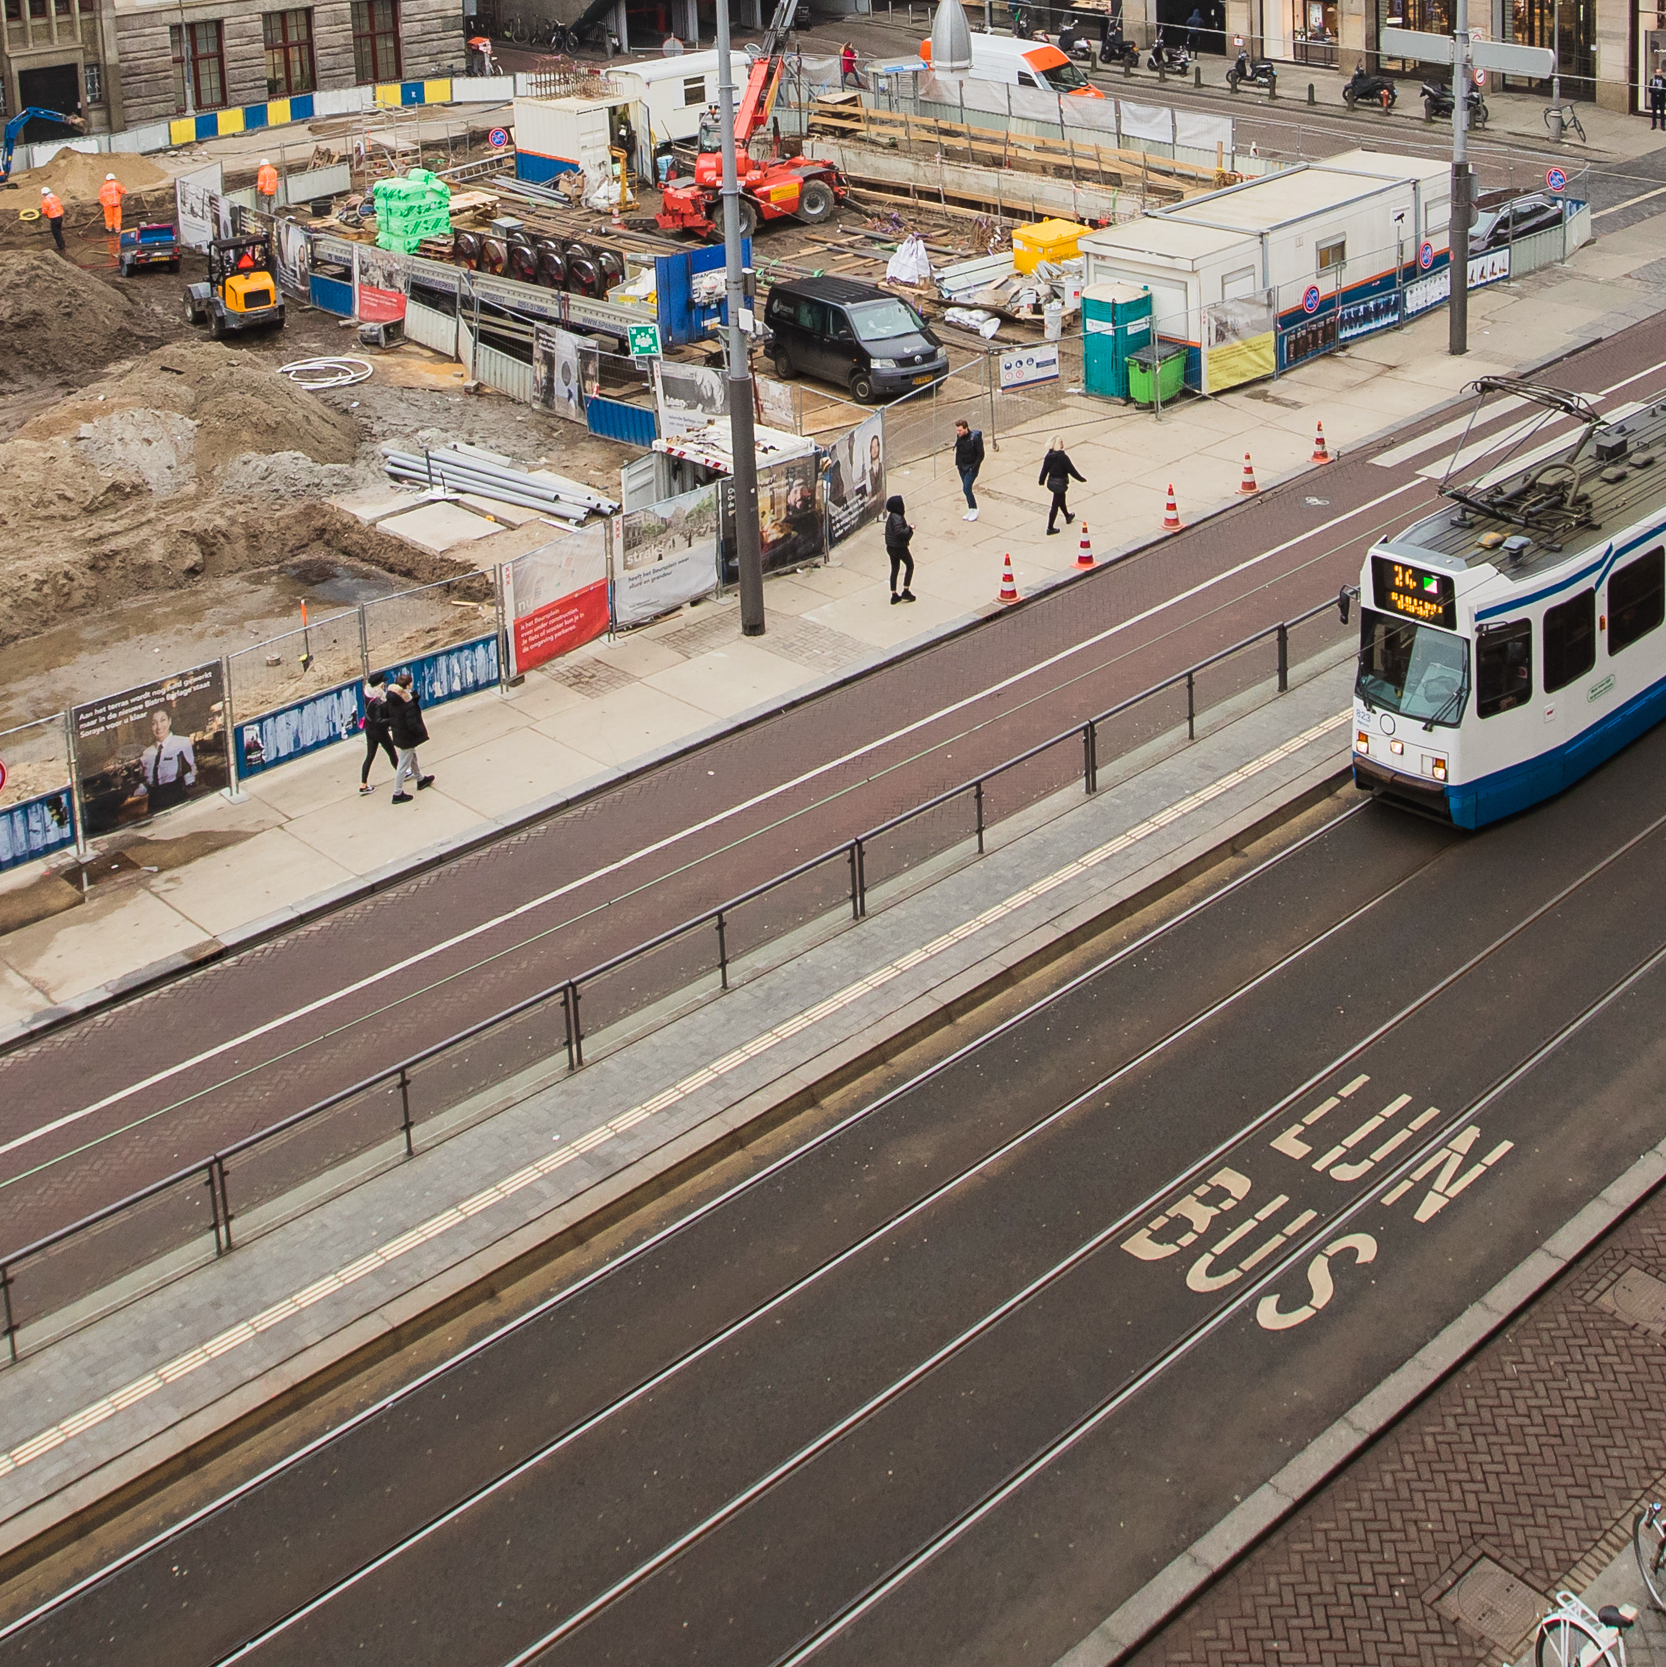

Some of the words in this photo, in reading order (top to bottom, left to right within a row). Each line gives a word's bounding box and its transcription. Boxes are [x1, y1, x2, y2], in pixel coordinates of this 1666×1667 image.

[518, 598, 533, 612] nu
[525, 620, 534, 629] het
[79, 711, 93, 721] Aan
[95, 706, 106, 716] het
[108, 700, 129, 711] terras
[130, 691, 151, 703] wordt
[152, 687, 166, 697] nog
[183, 671, 212, 688] gewerkt
[79, 719, 97, 729] maar
[98, 715, 106, 723] in
[107, 712, 117, 721] de
[118, 704, 143, 717] nieuwe
[144, 697, 165, 709] Bistro
[166, 688, 192, 702] Berlage
[193, 680, 211, 691] staat
[79, 725, 105, 739] Soraya
[106, 720, 122, 730] voor
[130, 711, 148, 722] klaar
[1356, 708, 1371, 723] 823
[1269, 1073, 1515, 1223] LIJN
[1120, 1166, 1379, 1332] BUS
